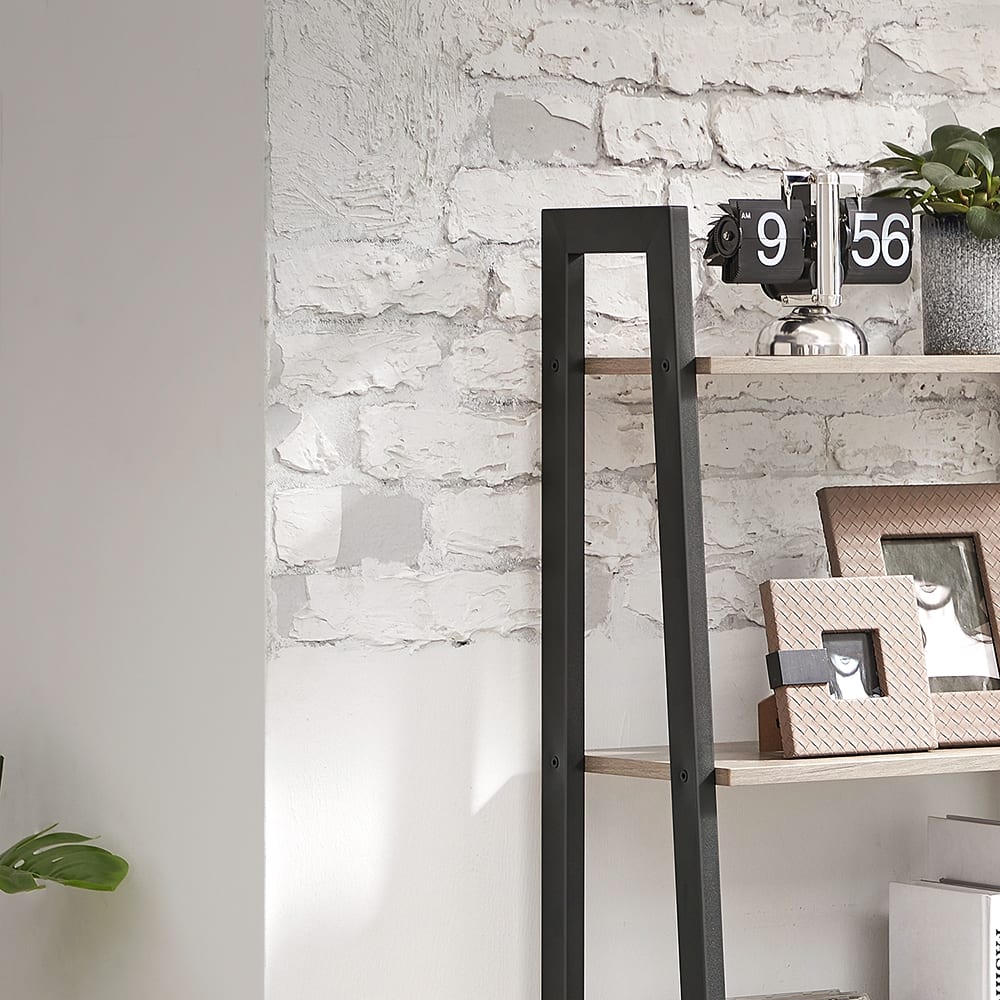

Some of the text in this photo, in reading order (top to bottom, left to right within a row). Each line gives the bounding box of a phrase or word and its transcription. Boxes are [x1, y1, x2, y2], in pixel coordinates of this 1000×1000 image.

[741, 211, 751, 219] AM
[757, 211, 911, 267] 9 56
